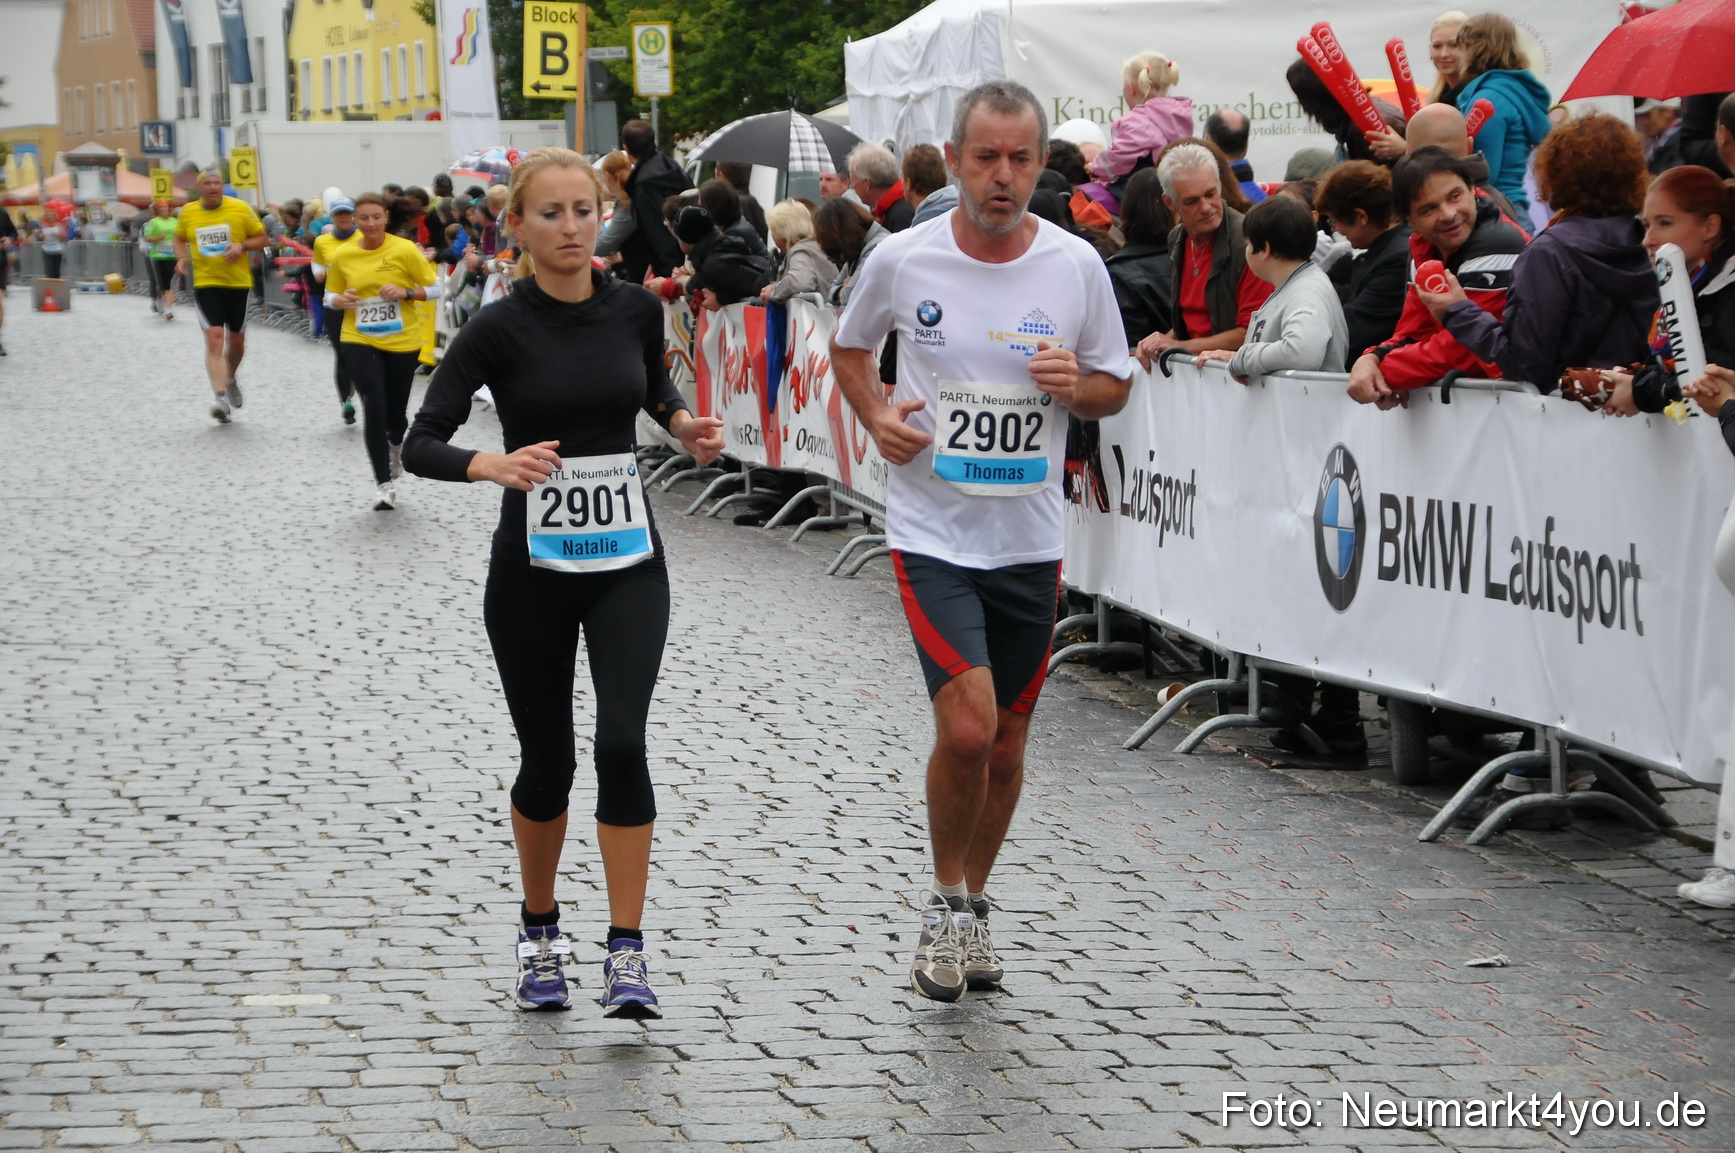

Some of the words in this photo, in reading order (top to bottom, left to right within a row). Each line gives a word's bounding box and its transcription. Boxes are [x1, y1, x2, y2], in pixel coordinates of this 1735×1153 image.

[532, 5, 578, 24] Block
[541, 31, 569, 76] B
[1343, 72, 1369, 106] BKK
[236, 159, 250, 179] C
[156, 178, 167, 194] D
[360, 304, 396, 323] 2258
[914, 328, 946, 340] PARTL
[914, 337, 946, 347] Neumarkt
[940, 391, 979, 404] PARTL
[982, 394, 1037, 406] Neumarkt
[947, 408, 1044, 453] 2902
[571, 466, 624, 480] Neumarkt
[963, 462, 1025, 480] Thomas
[1320, 448, 1361, 504] BMW
[540, 482, 632, 528] 2901
[562, 537, 618, 556] Natalie
[1378, 492, 1477, 594] BMW
[1484, 505, 1645, 644] Laufsport
